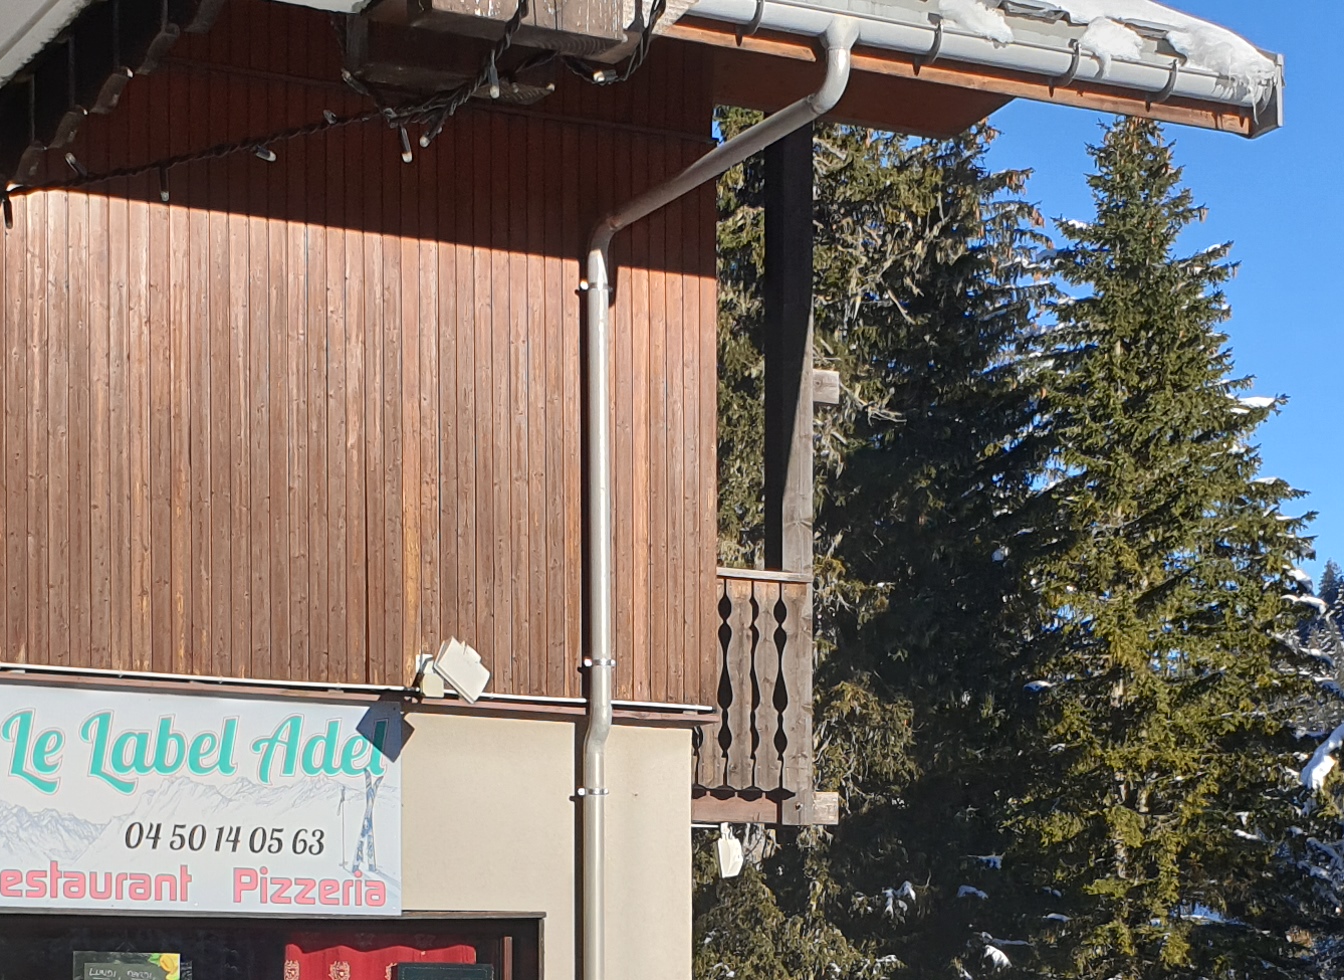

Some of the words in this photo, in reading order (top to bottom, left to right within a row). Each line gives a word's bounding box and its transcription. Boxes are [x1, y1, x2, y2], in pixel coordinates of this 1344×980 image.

[1, 709, 64, 793] Le
[80, 710, 238, 794] Label
[252, 714, 388, 784] Adel
[124, 821, 162, 850] 04
[169, 823, 207, 852] 50
[214, 825, 242, 853] 14
[249, 826, 284, 854] 05
[291, 828, 325, 856] 63
[232, 866, 387, 907] Pizzeria
